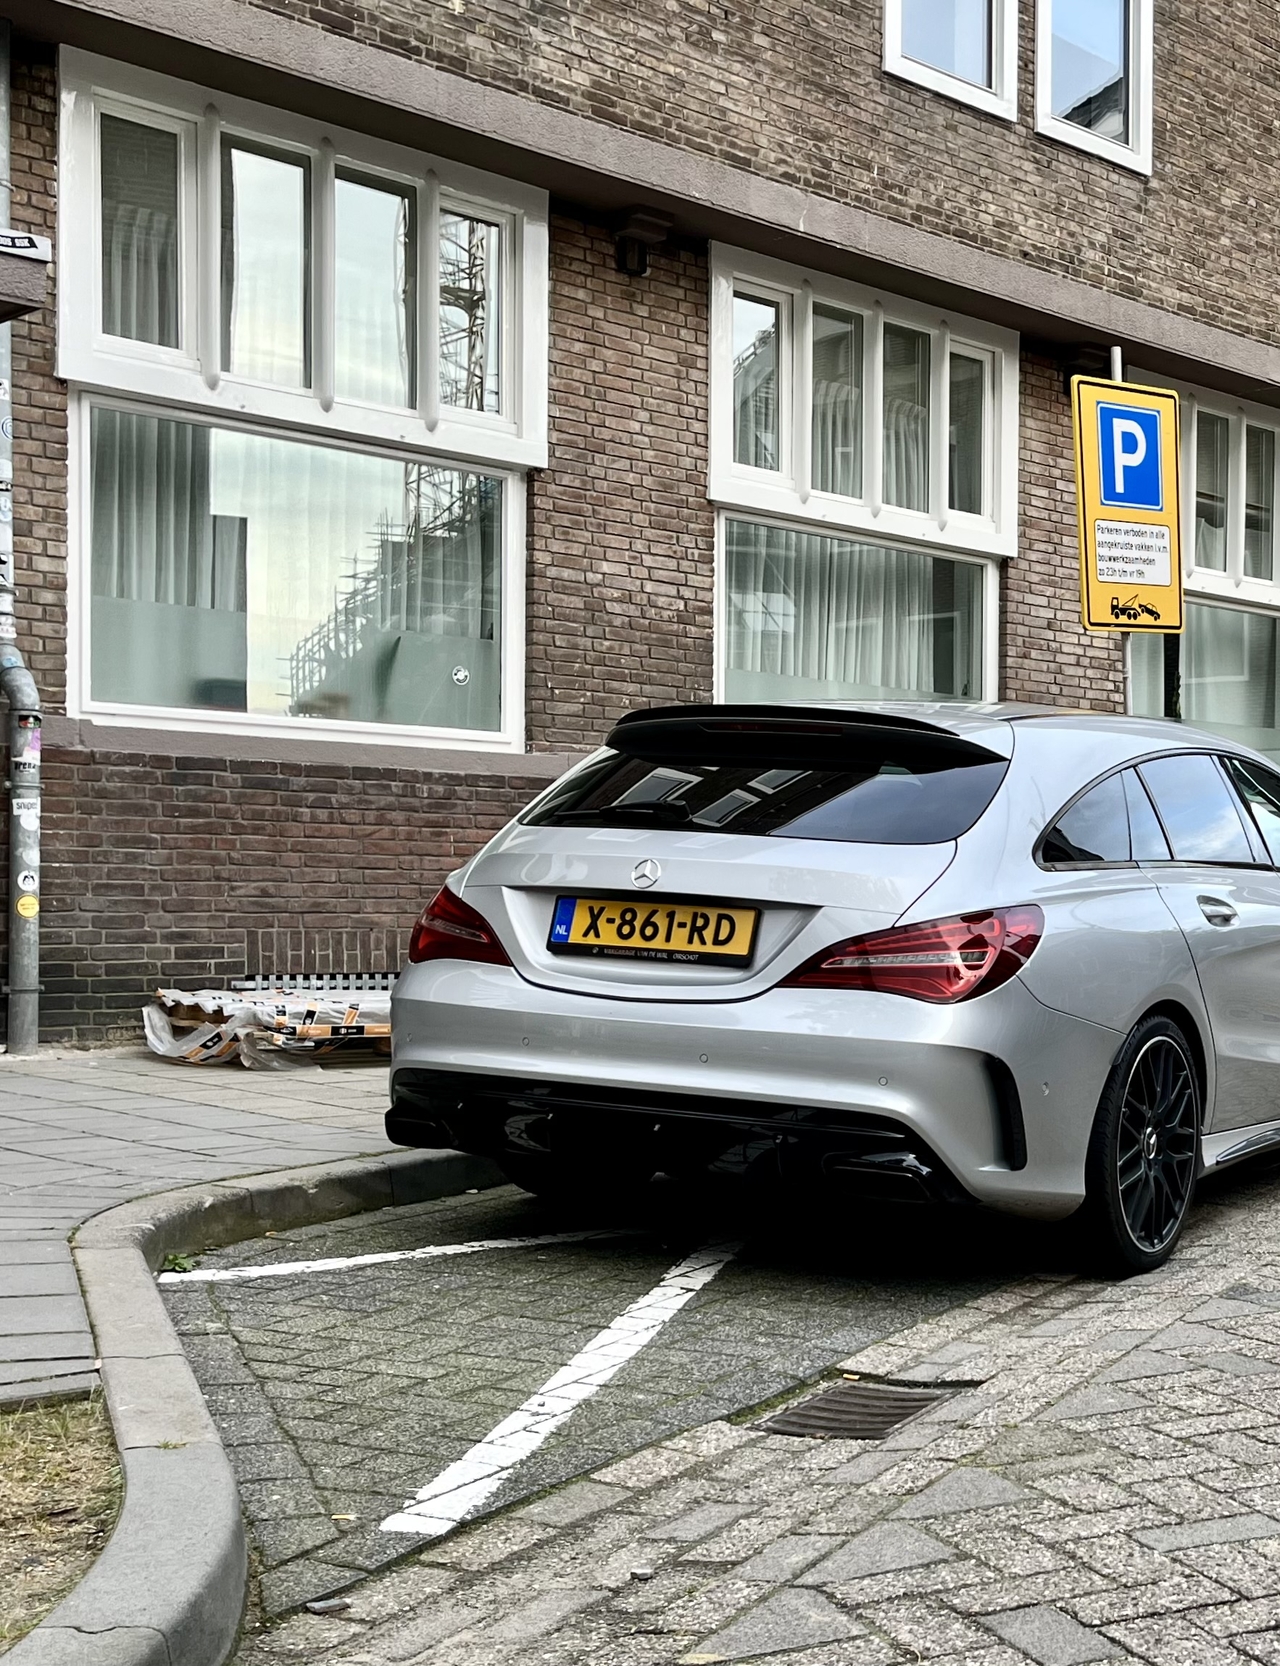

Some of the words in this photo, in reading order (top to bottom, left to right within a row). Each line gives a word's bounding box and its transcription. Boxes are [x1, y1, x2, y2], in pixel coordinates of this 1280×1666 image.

[1112, 418, 1147, 493] P
[1097, 524, 1122, 536] Parkeren
[1123, 528, 1147, 537] verboden
[1149, 529, 1154, 538] in
[1155, 531, 1165, 539] alle
[1097, 540, 1133, 551] aangekruiste
[1134, 542, 1153, 552] vakken
[1098, 552, 1156, 565] bouwwerkzaamheden
[555, 924, 568, 936] NL
[582, 905, 736, 947] X-861-RD
